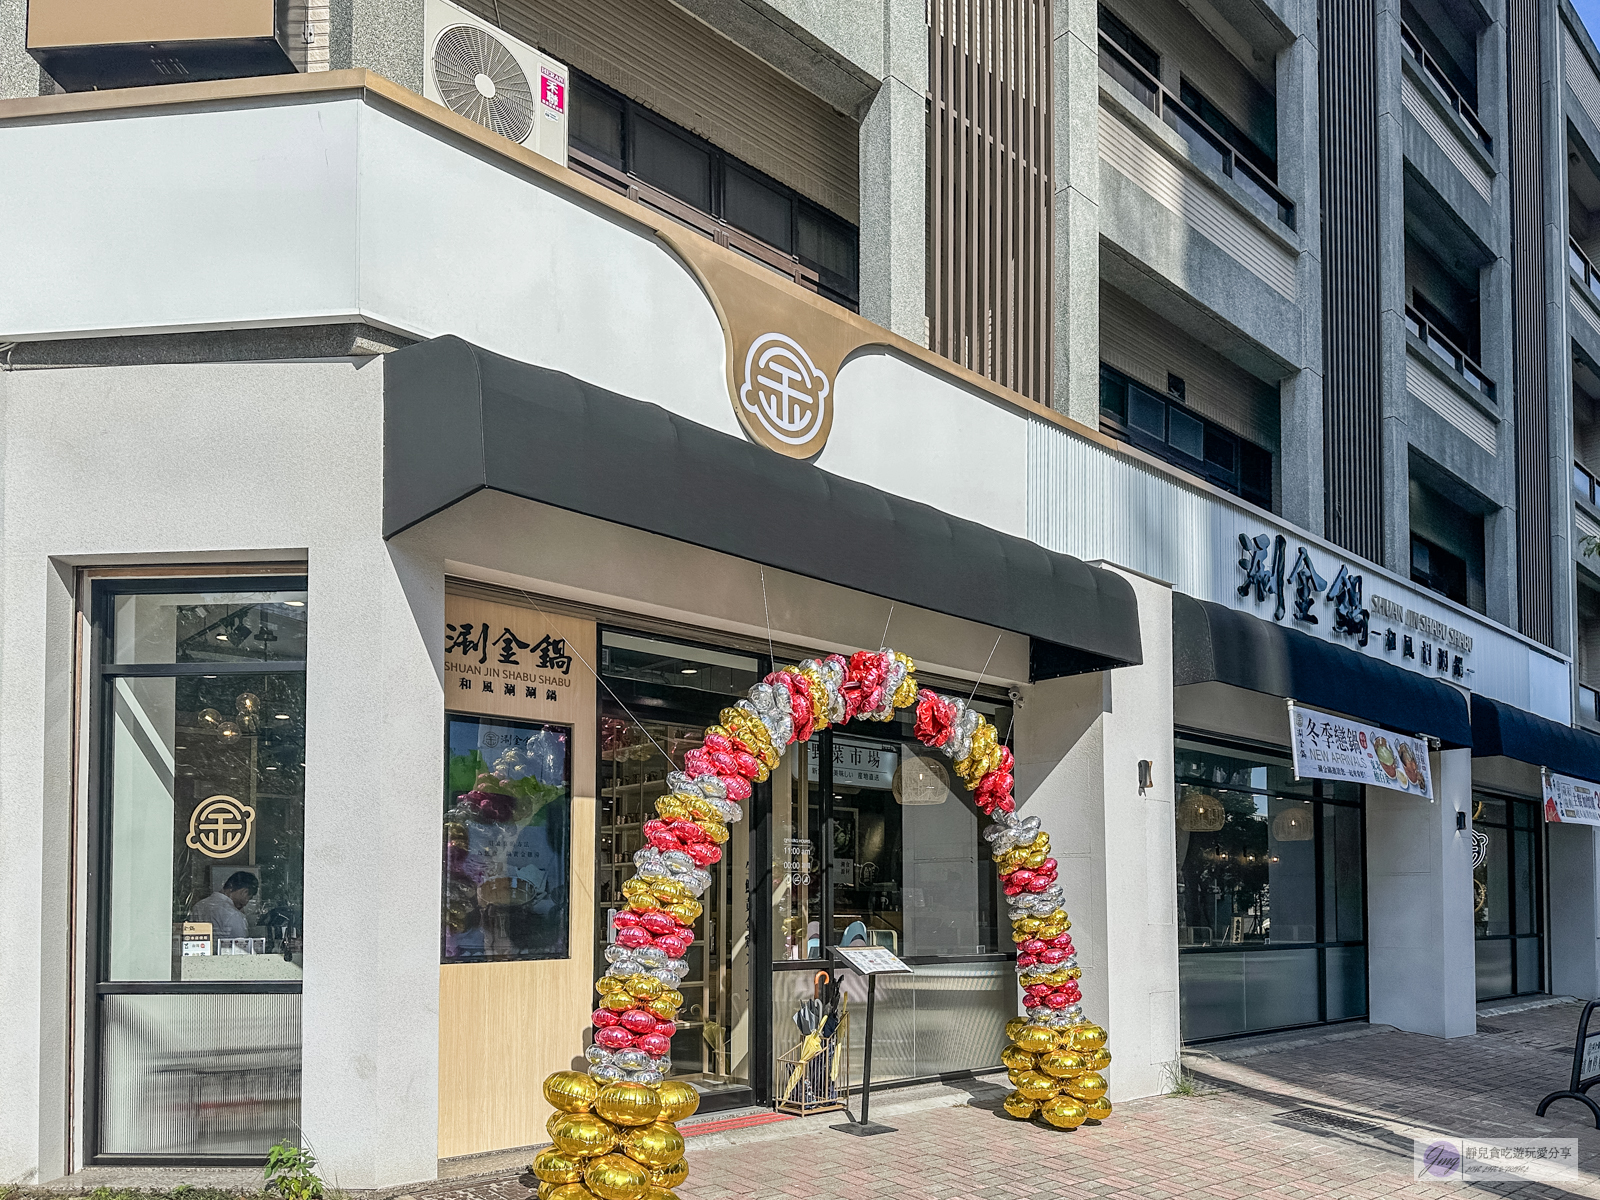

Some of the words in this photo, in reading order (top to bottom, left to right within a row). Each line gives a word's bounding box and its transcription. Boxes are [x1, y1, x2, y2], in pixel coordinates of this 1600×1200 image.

[546, 80, 558, 106] 禾聯
[1237, 532, 1370, 647] 涮金鍋
[1371, 594, 1403, 623] SHUAN
[1405, 609, 1418, 631] JIN
[1419, 617, 1447, 641] SHABU
[1448, 628, 1473, 653] SHABU
[445, 623, 572, 675] 涮金鍋
[444, 661, 481, 676] SHUAN
[484, 667, 500, 678] JIN
[502, 669, 537, 683] SHABU
[538, 675, 571, 688] SHABU
[459, 677, 557, 702] 和風涮涮鍋
[1306, 717, 1362, 755] 冬季戀鍋
[1309, 748, 1329, 762] NEW
[1331, 752, 1367, 769] ARRIVALS
[784, 847, 800, 855] 11:00
[783, 861, 800, 870] 00:00
